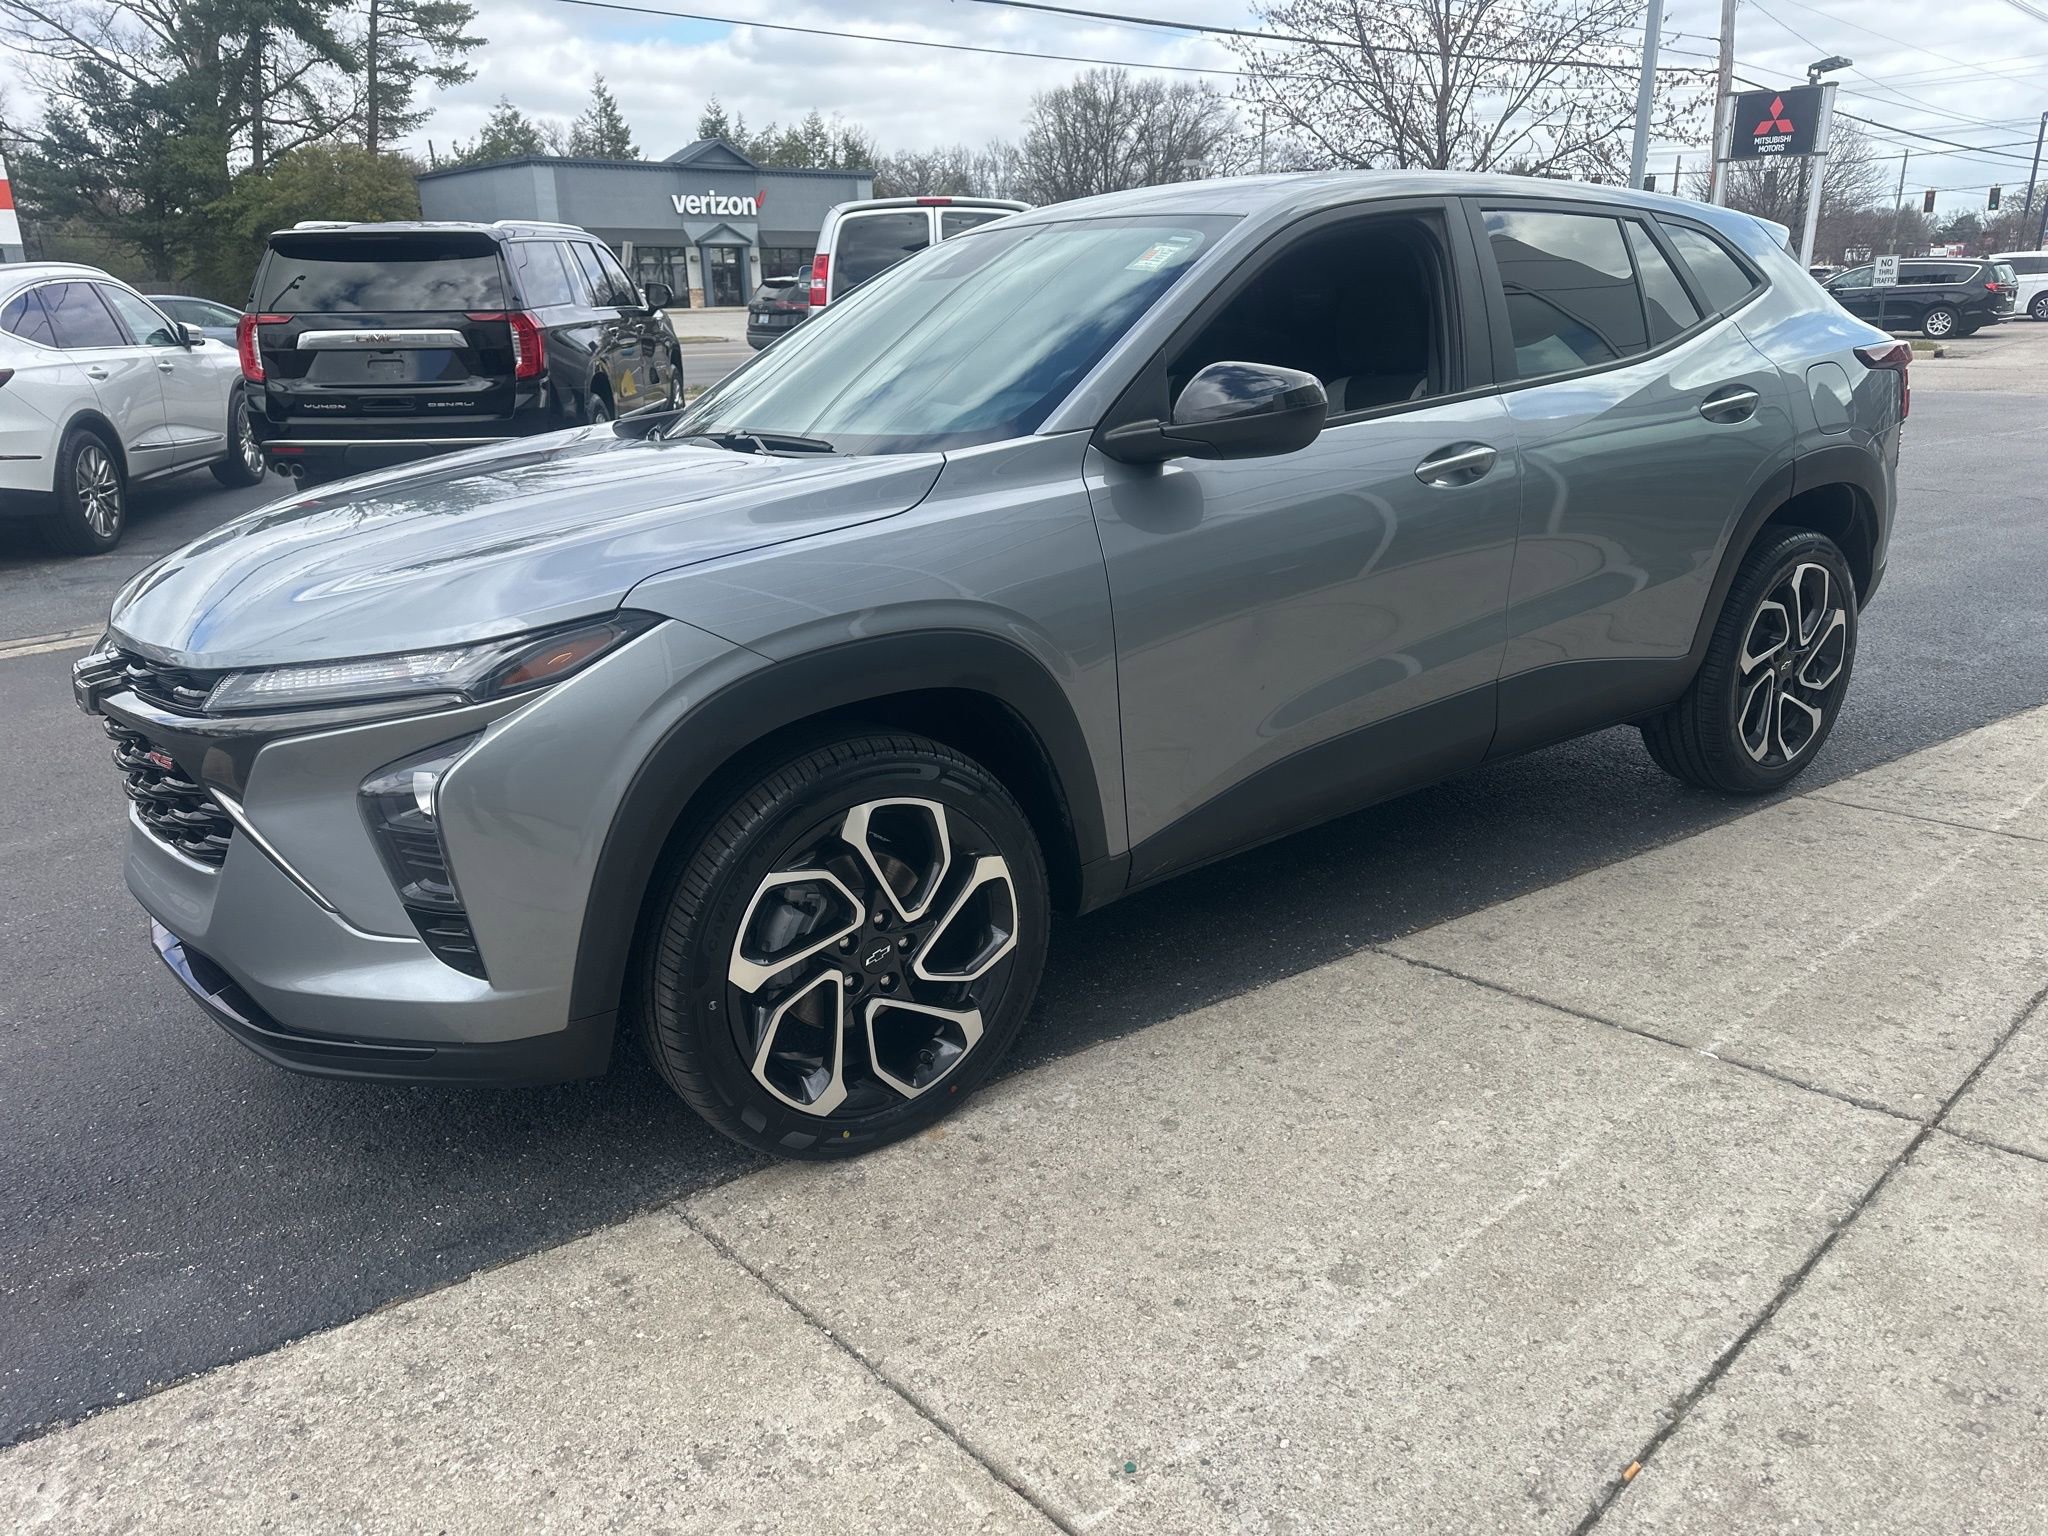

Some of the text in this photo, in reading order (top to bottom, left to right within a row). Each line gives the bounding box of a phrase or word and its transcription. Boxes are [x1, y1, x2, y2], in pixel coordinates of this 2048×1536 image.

[1753, 135, 1792, 145] MITSUBISHI
[1758, 144, 1785, 153] MOTORS
[671, 190, 757, 215] verizon
[1881, 259, 1893, 267] NO
[355, 334, 401, 343] GMC
[150, 751, 173, 769] RS
